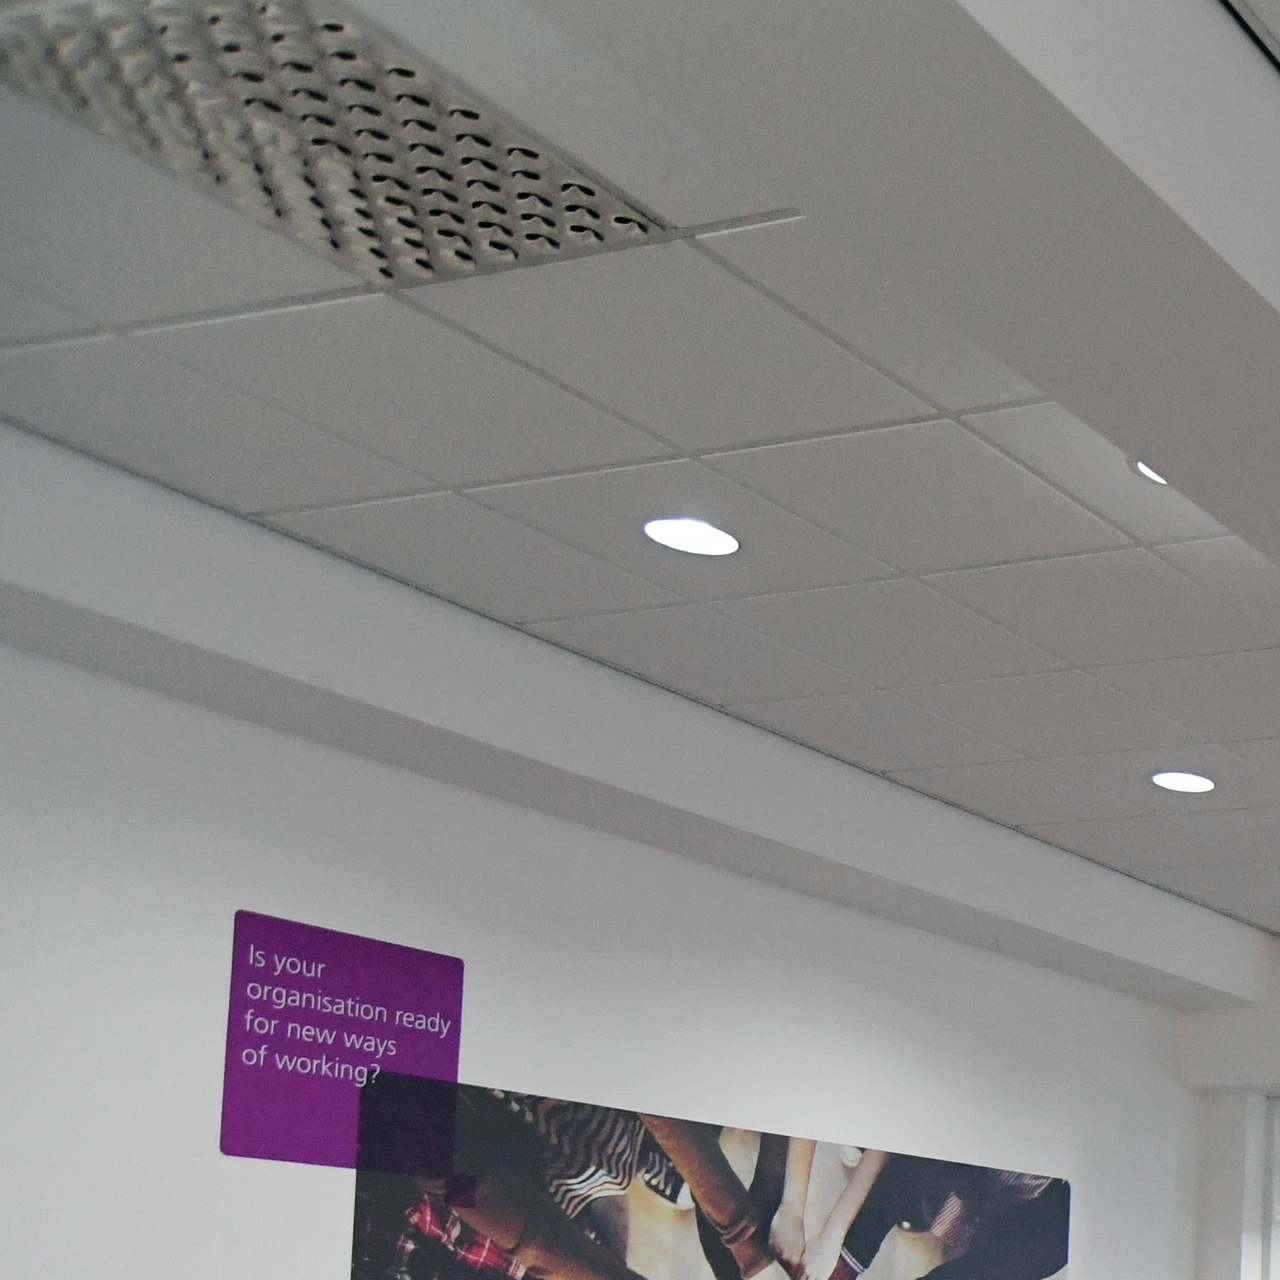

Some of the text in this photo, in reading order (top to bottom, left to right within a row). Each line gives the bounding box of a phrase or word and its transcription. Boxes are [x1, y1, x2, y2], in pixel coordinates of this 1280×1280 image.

[248, 944, 326, 978] Is your
[246, 981, 452, 1038] organisation ready
[244, 1010, 397, 1058] for new ways
[241, 1044, 381, 1087] of working?
